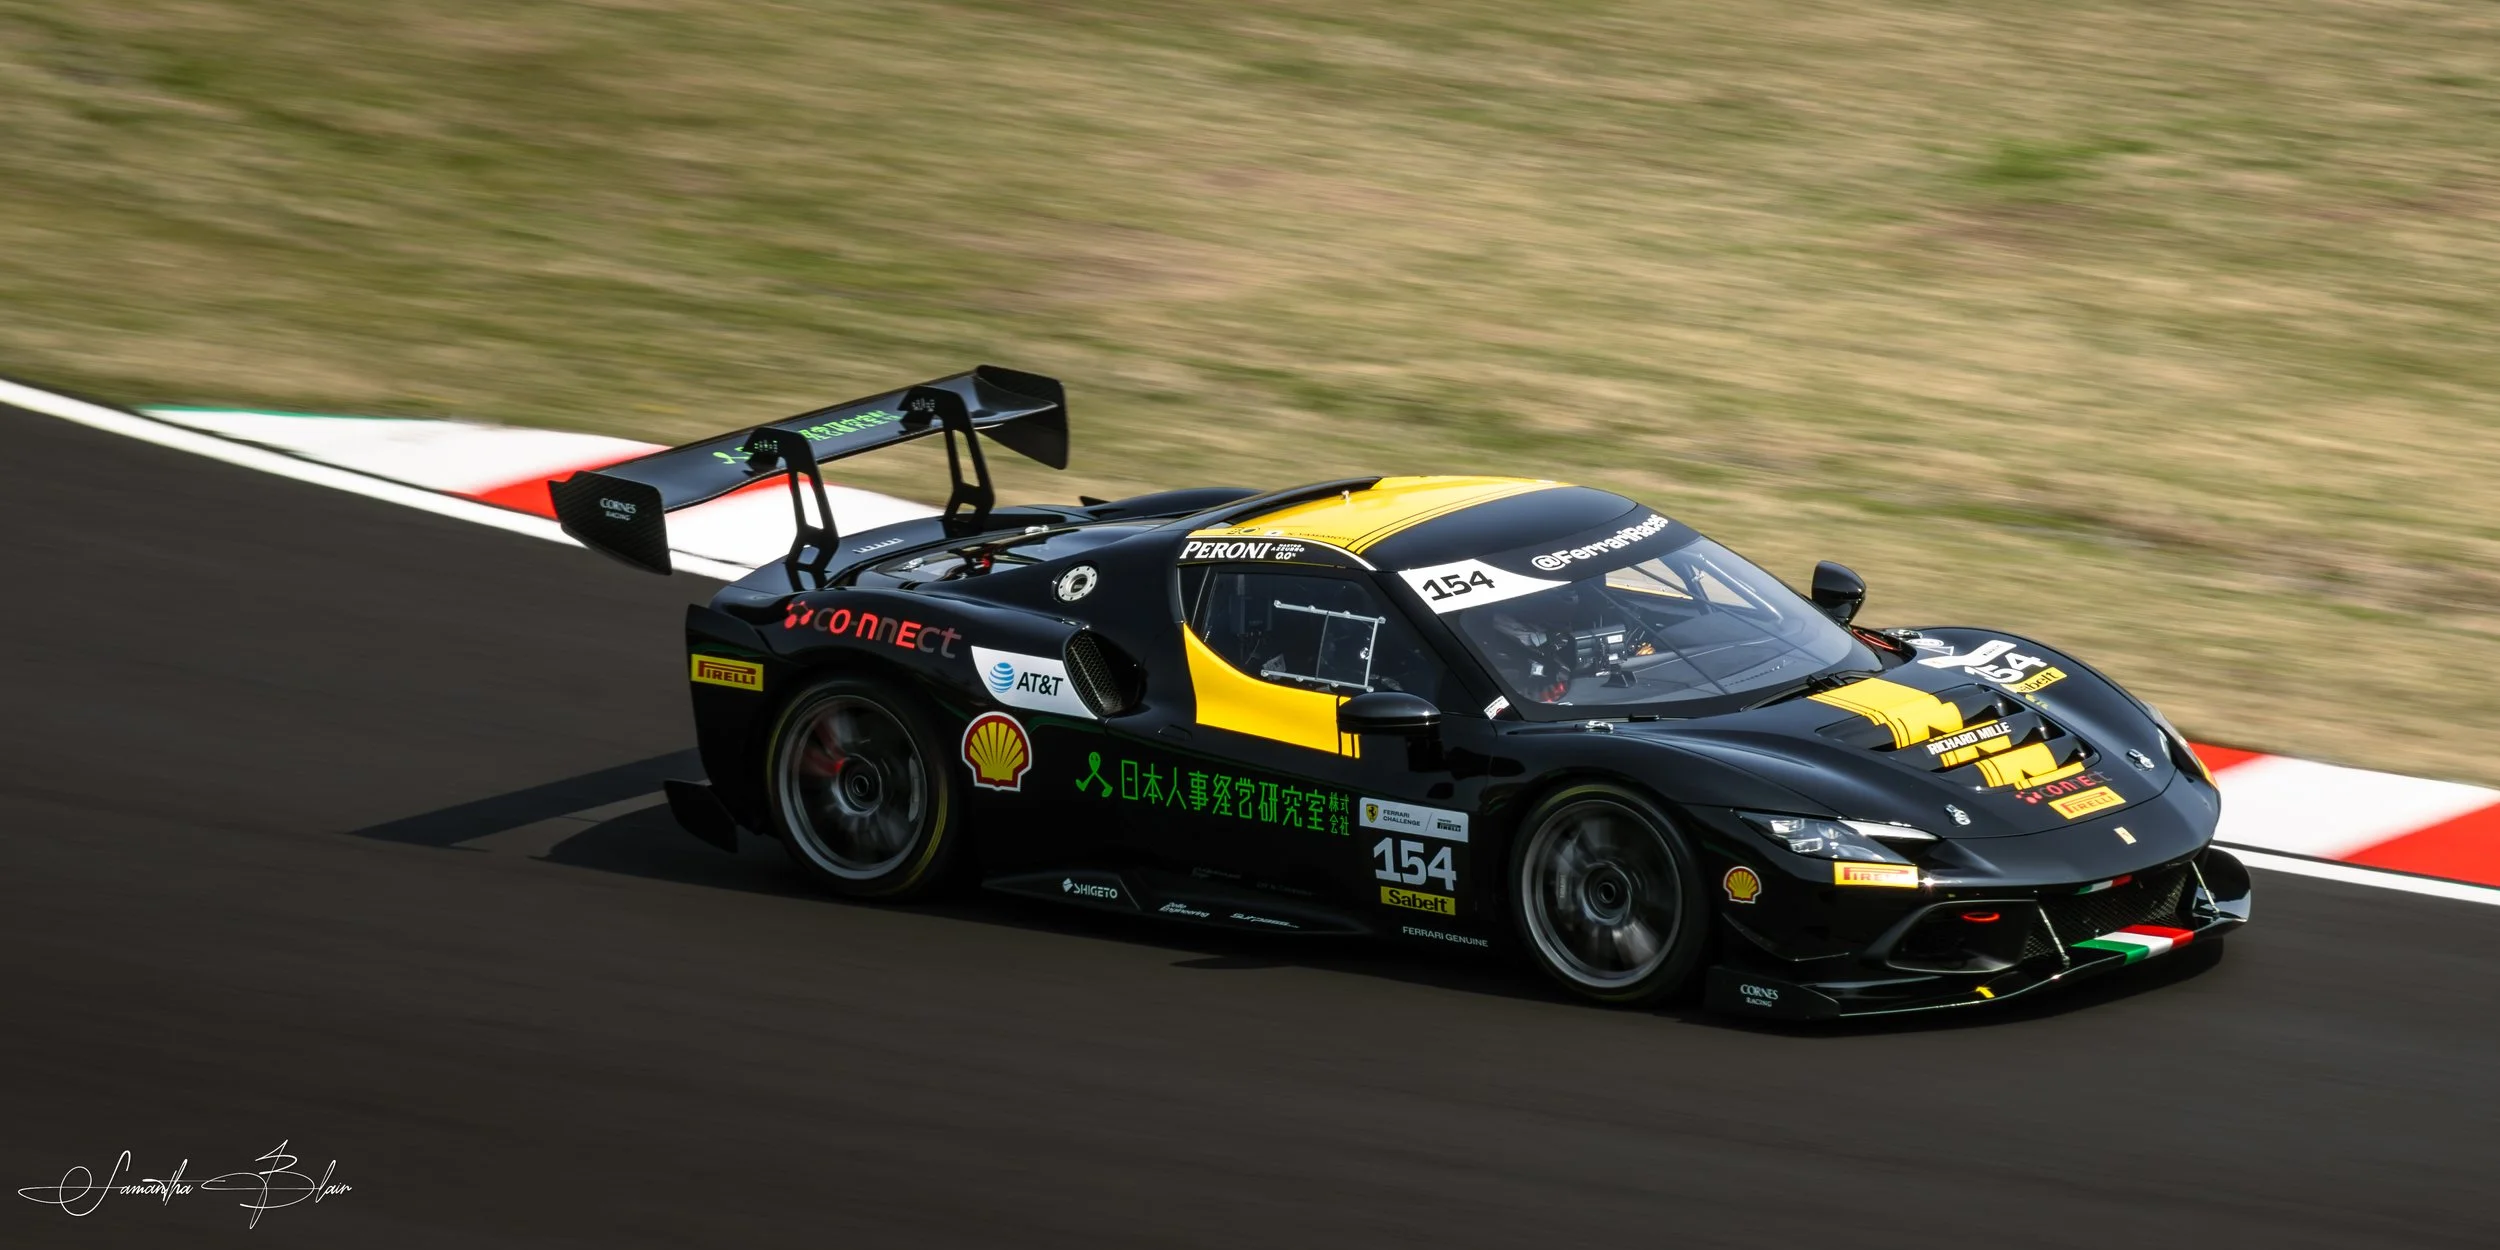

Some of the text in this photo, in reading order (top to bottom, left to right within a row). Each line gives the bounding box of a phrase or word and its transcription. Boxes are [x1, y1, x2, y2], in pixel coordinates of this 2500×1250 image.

[1179, 541, 1273, 559] PERONI
[1531, 514, 1669, 571] @FerrariRaces
[1422, 570, 1496, 601] 154
[698, 660, 756, 686] PIRELLI
[2014, 671, 2060, 692] abelt
[1016, 671, 1064, 697] AT&T
[1926, 721, 2011, 756] RICHARD MILLE
[1120, 759, 1326, 832] 日本人事経営研究室
[2060, 791, 2114, 814] PIRELLI
[1382, 815, 1421, 827] CHALLENGE
[1383, 809, 1410, 819] FERRARI
[1373, 837, 1457, 891] 154
[1844, 866, 1908, 881] PIRE
[1073, 883, 1118, 899] SHIGETO
[1388, 893, 1448, 914] Sabelt
[1402, 926, 1489, 947] FERRARI GENUINE
[1740, 984, 1779, 1000] CORNES
